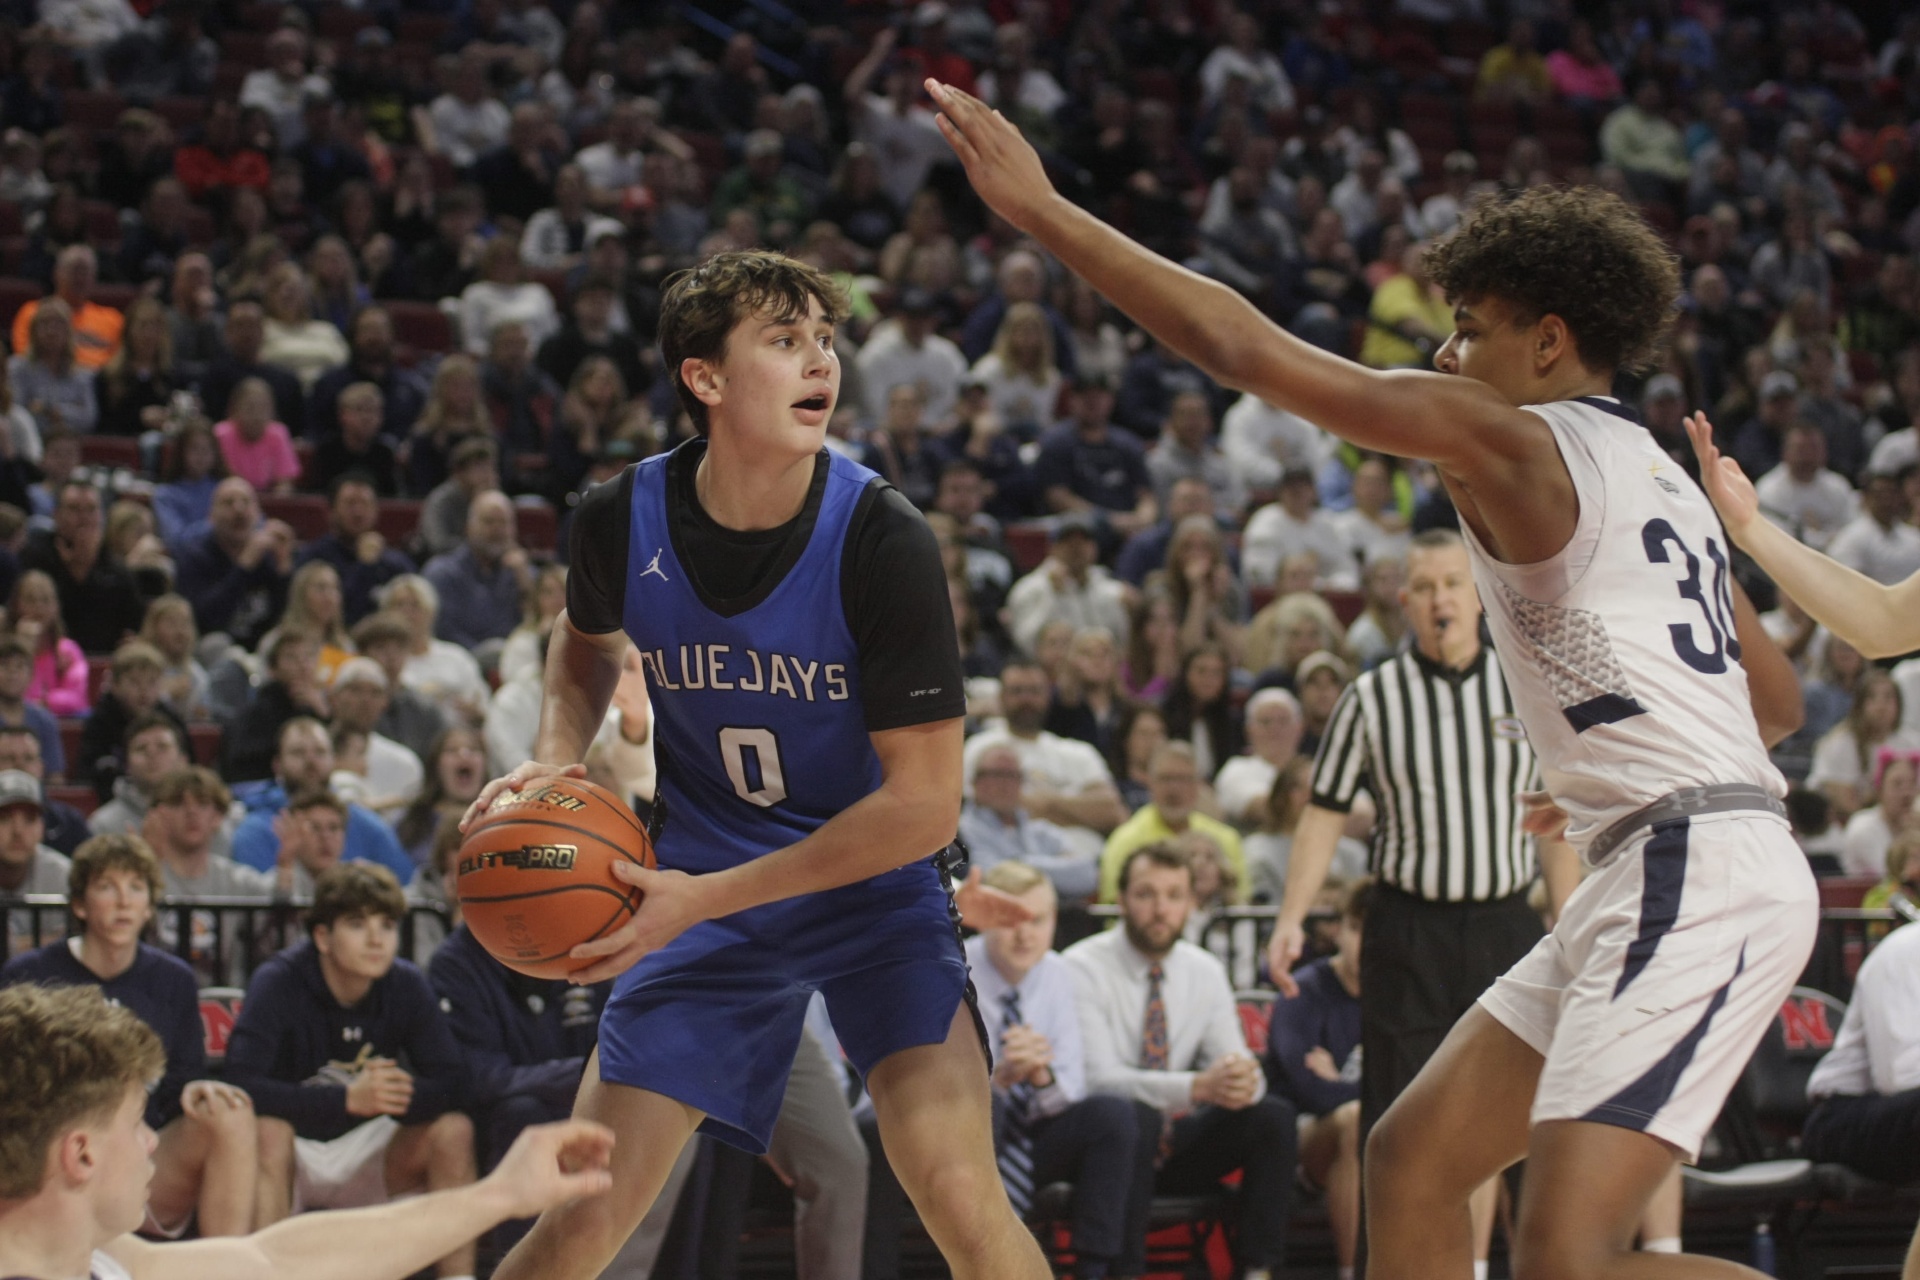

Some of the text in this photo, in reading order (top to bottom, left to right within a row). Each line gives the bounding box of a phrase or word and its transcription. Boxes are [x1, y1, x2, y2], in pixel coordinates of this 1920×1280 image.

[640, 643, 849, 702] BLUEJAYS
[716, 725, 789, 809] 0
[527, 847, 573, 868] PRO
[1779, 996, 1836, 1050] N
